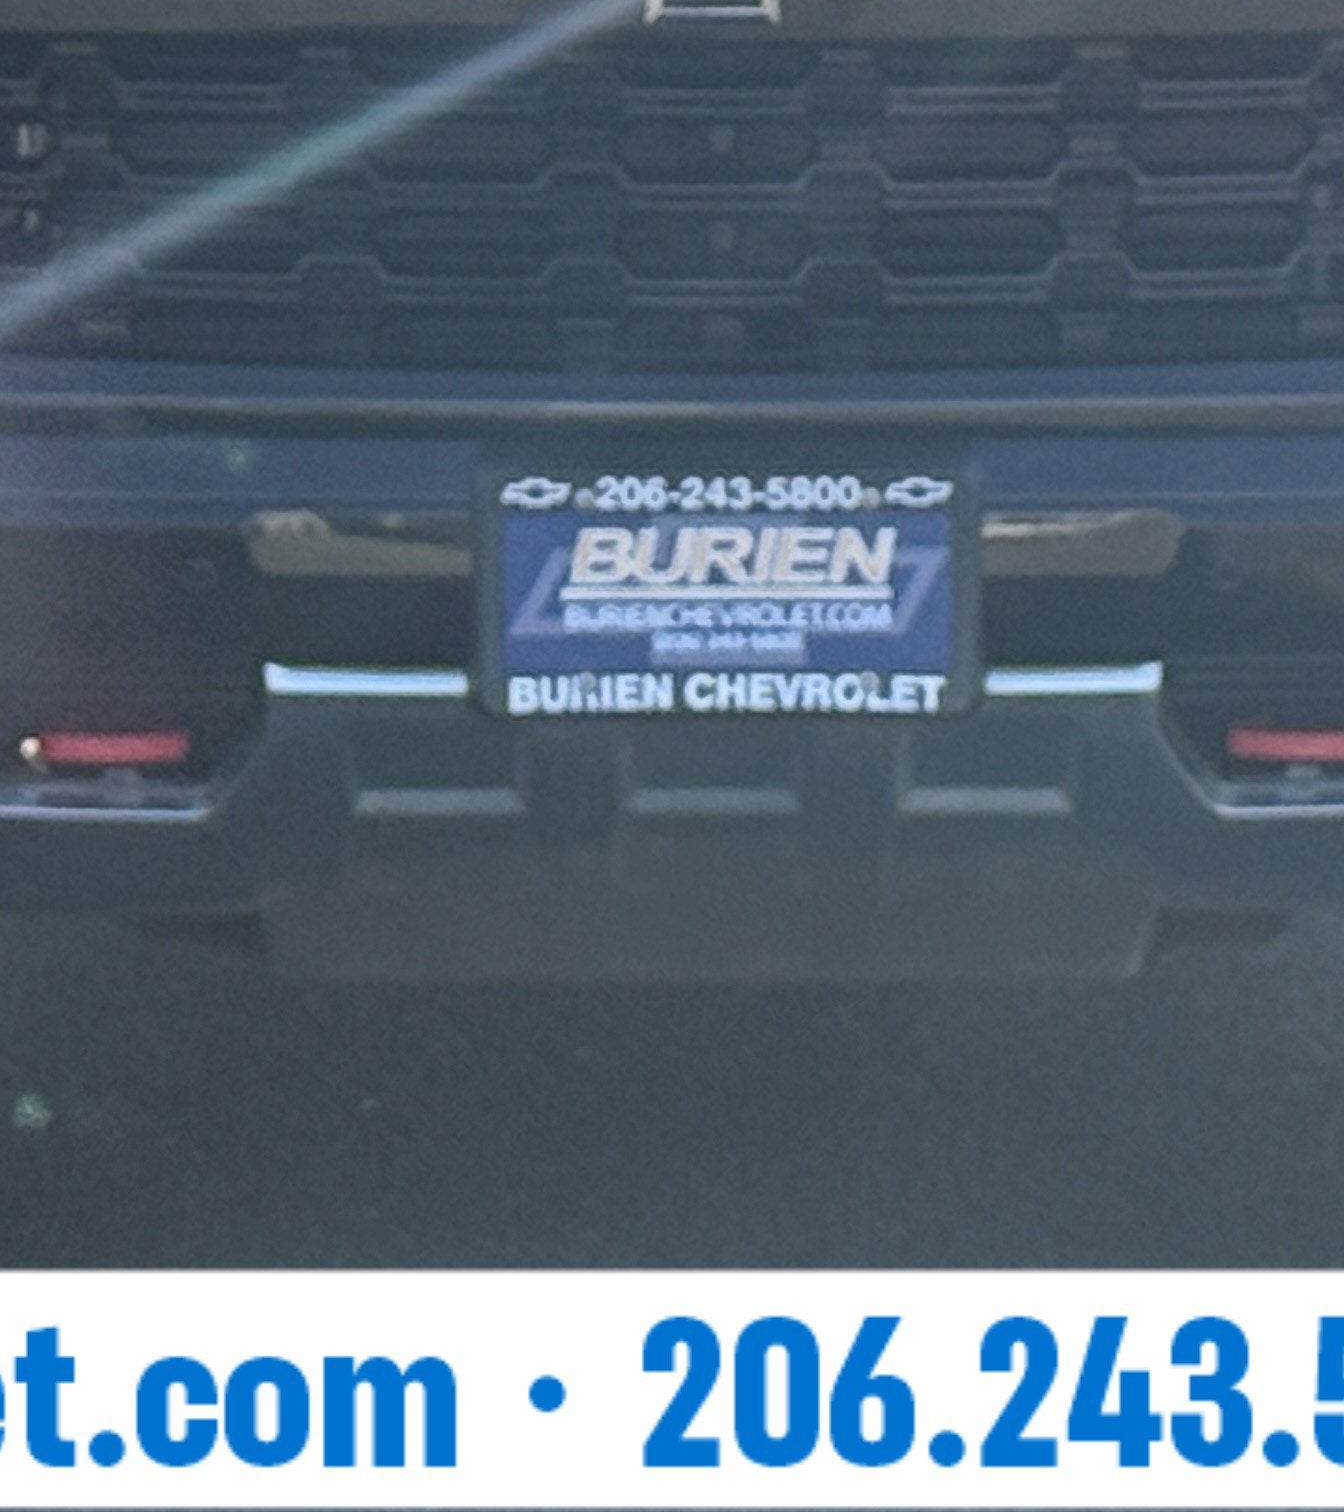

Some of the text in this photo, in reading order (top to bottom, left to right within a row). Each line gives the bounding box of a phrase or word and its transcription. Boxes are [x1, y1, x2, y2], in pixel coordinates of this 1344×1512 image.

[594, 475, 861, 511] 206-243-5800
[569, 526, 898, 584] BURIEN
[508, 672, 947, 714] BURIEN CHEVROLET
